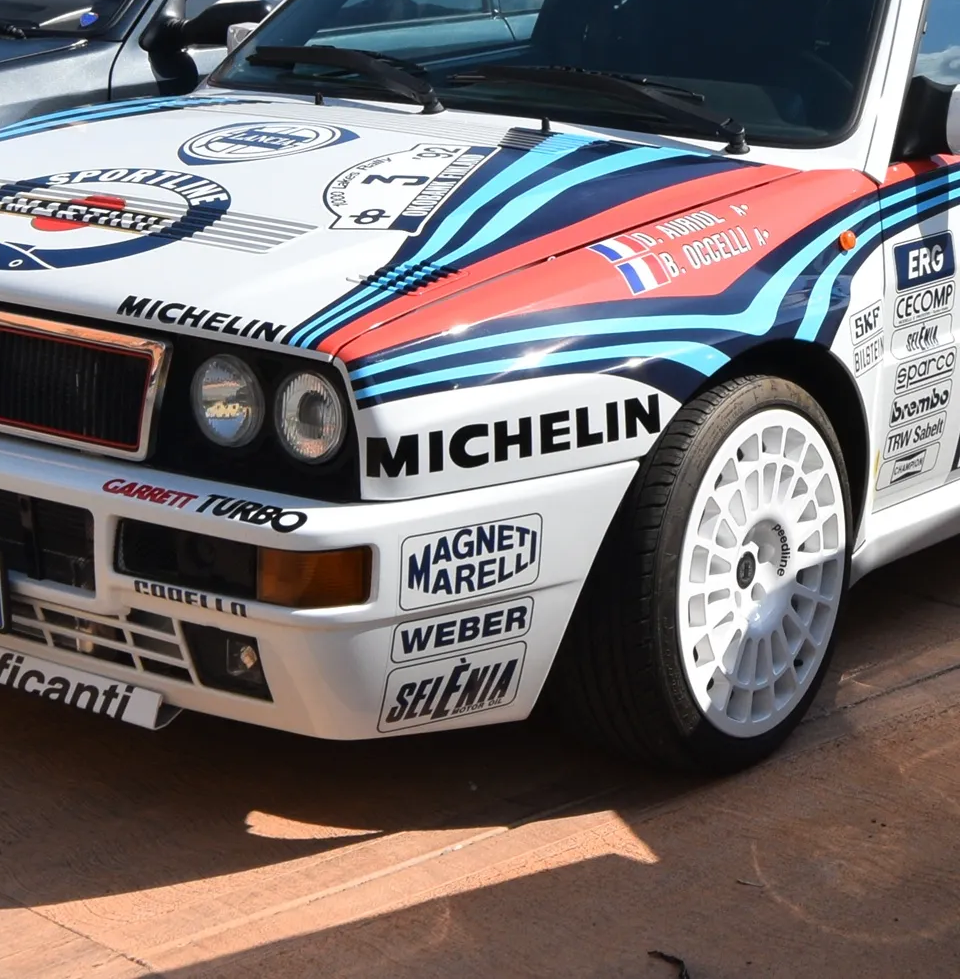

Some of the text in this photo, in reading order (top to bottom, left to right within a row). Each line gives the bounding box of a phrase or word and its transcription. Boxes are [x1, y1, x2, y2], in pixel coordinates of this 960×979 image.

[47, 168, 228, 207] SPORTLINE
[361, 174, 430, 186] 3
[655, 210, 726, 240] AURIOL
[659, 252, 687, 278] B.
[682, 226, 753, 270] OCCELLI
[908, 244, 944, 280] ERG
[116, 295, 287, 343] MICHELIN
[896, 284, 953, 319] CECOMP
[854, 306, 881, 340] SKF
[896, 352, 955, 389] sparco
[891, 388, 949, 424] brembo
[366, 393, 661, 478] MICHELIN
[887, 417, 944, 453] TRW Sabelt
[893, 458, 925, 476] CHAMPION
[102, 478, 308, 533] GARRETT TURBO
[408, 525, 538, 593] MAGNETI
[401, 605, 527, 655] WEBER
